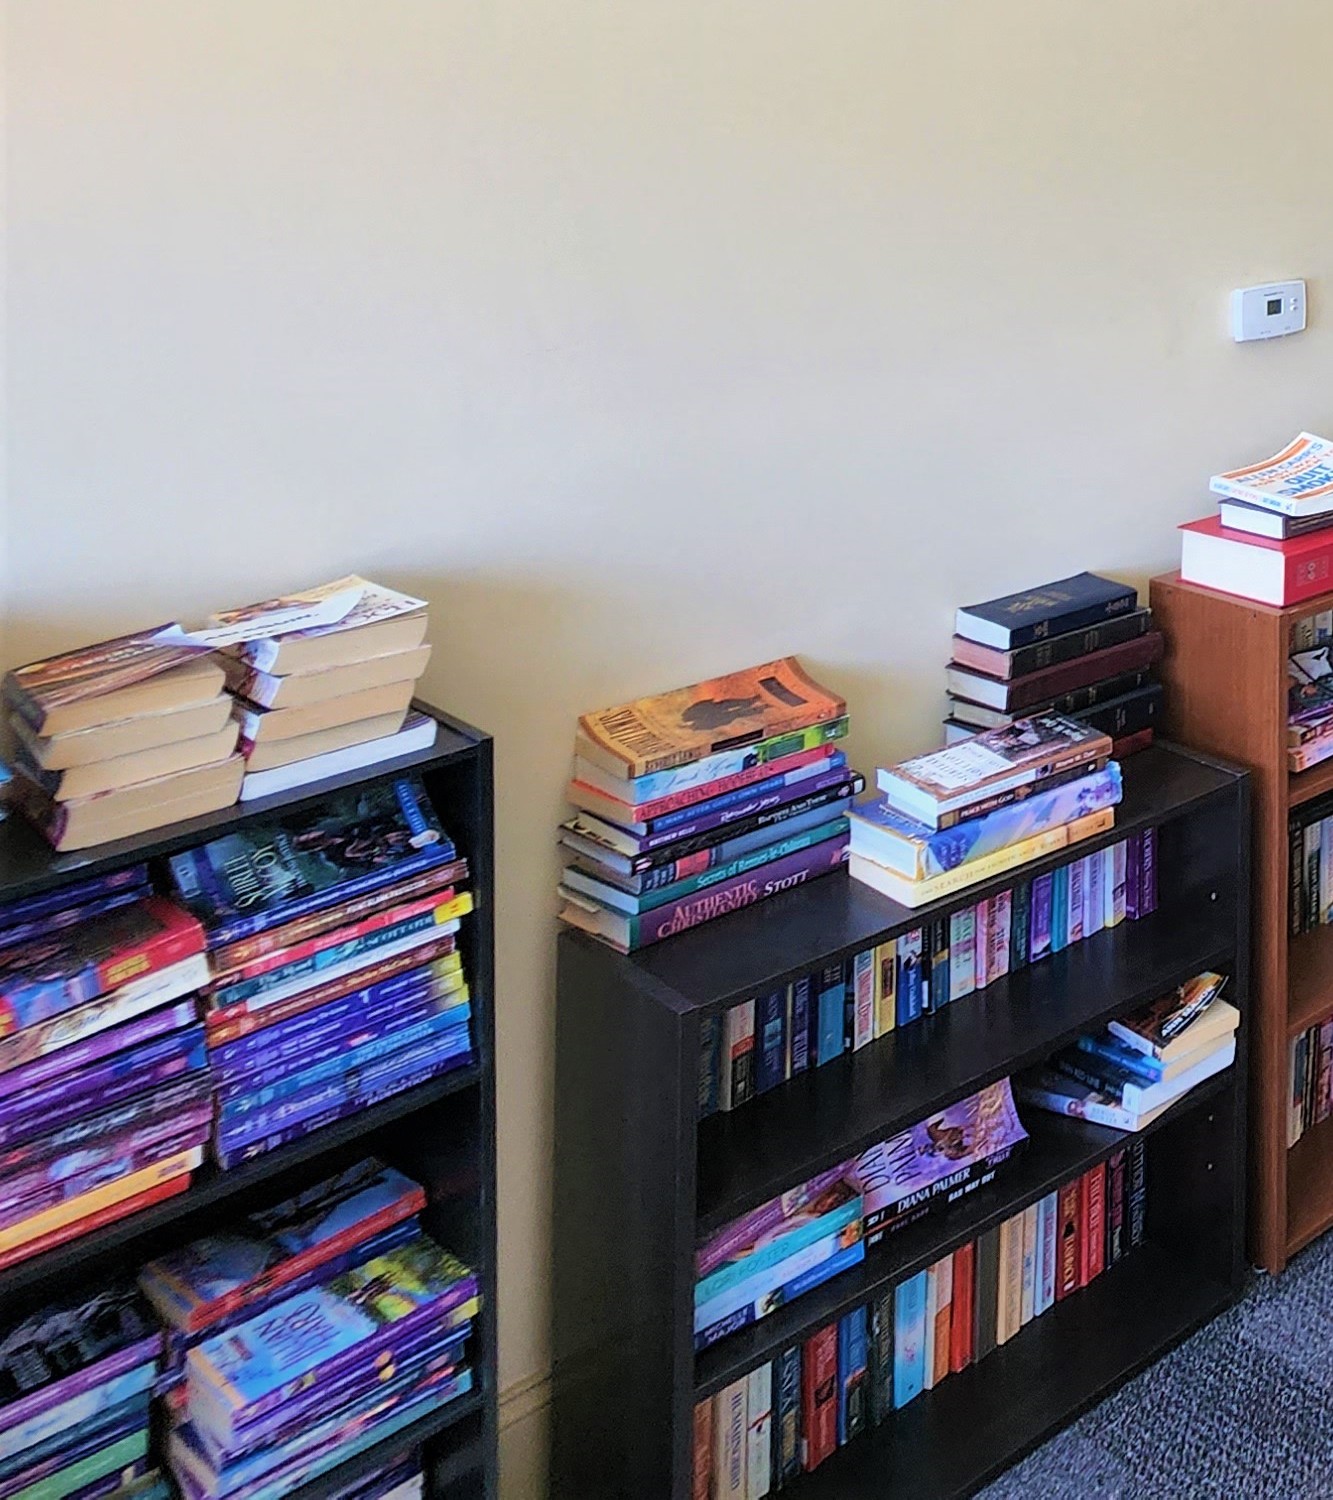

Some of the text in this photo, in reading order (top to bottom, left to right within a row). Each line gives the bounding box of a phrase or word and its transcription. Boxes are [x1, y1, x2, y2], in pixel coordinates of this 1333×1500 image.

[1236, 468, 1278, 484] ALLEN
[1283, 463, 1332, 485] QUIT
[998, 793, 1014, 805] GOD
[697, 869, 727, 888] Secrets
[727, 863, 737, 877] of
[763, 868, 810, 897] STOTT
[673, 879, 758, 920] AUTHENTIC
[657, 891, 759, 938] CHRISTIANITY
[896, 1167, 971, 1214] DIANA PALMER
[739, 1241, 789, 1274] FOSTER
